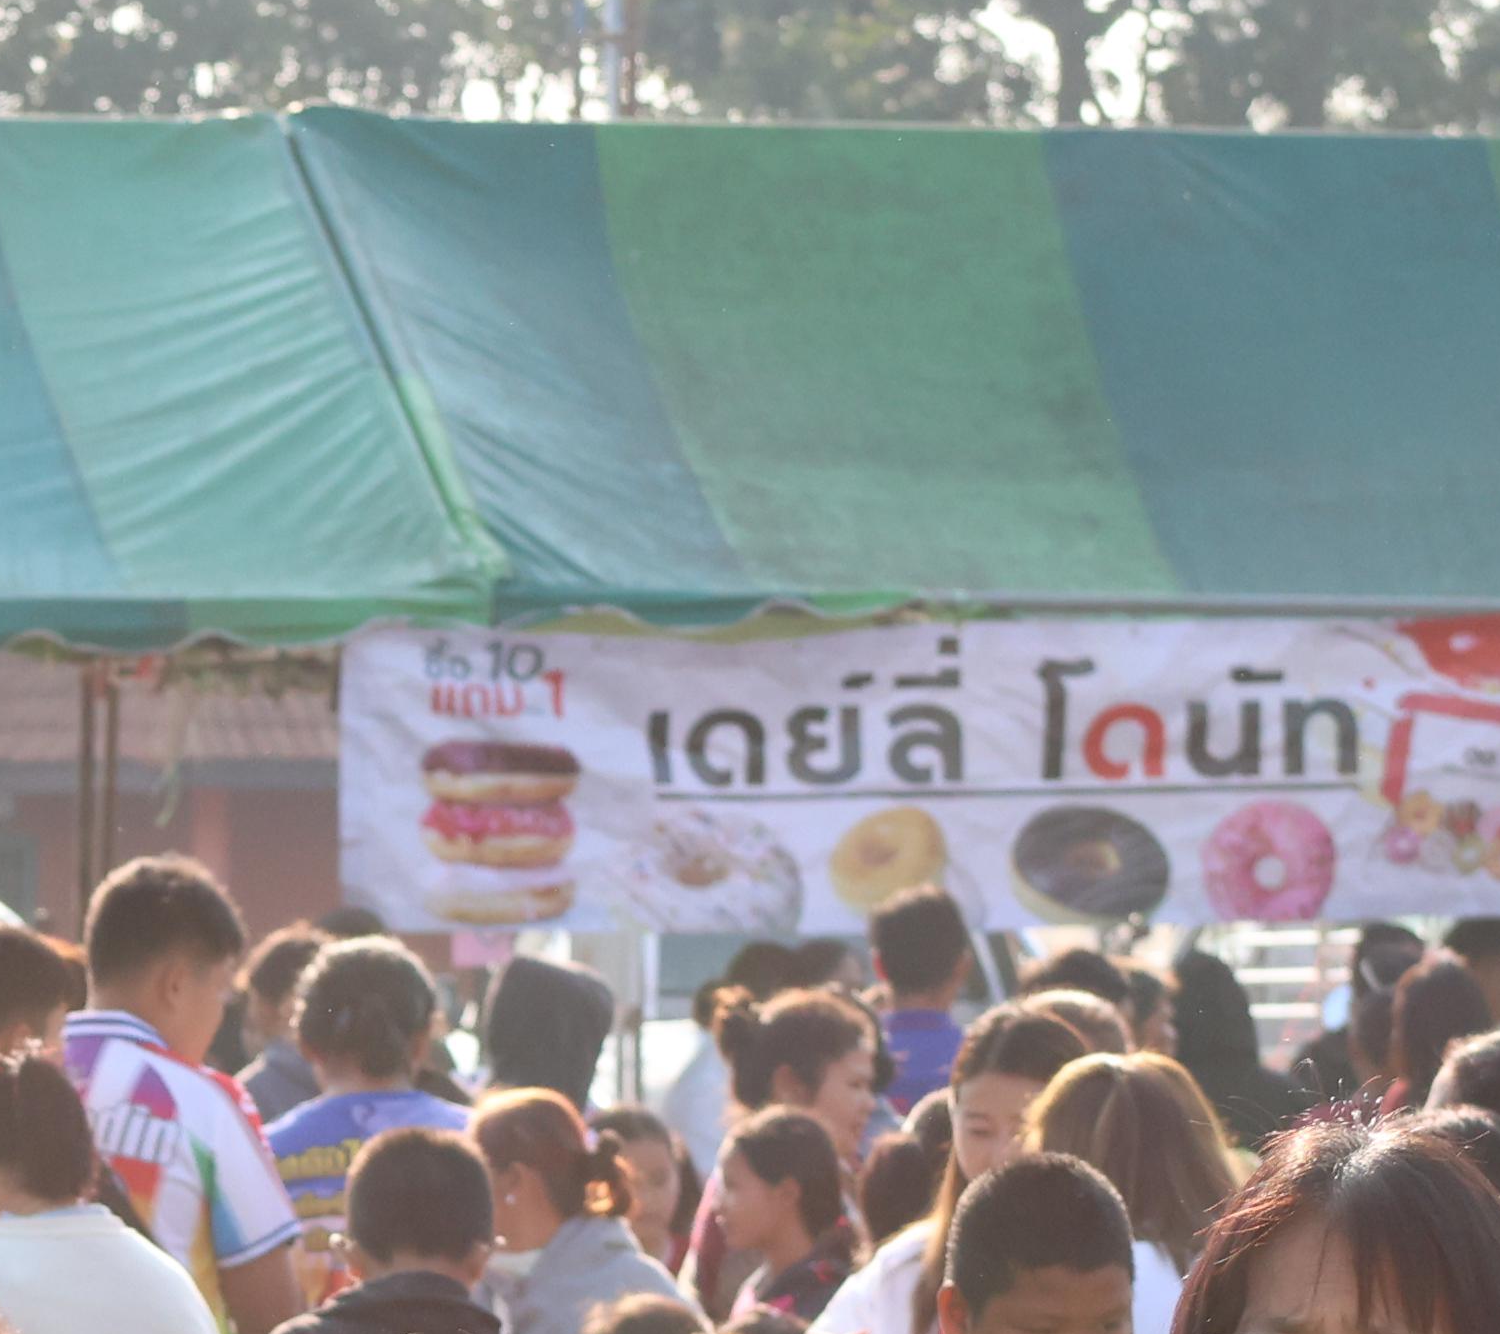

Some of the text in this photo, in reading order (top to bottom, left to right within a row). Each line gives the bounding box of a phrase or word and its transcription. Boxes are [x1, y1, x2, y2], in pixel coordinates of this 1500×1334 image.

[486, 640, 545, 682] 10
[539, 668, 566, 721] 1
[646, 637, 1360, 787] เดย์ลี่ โดนัท
